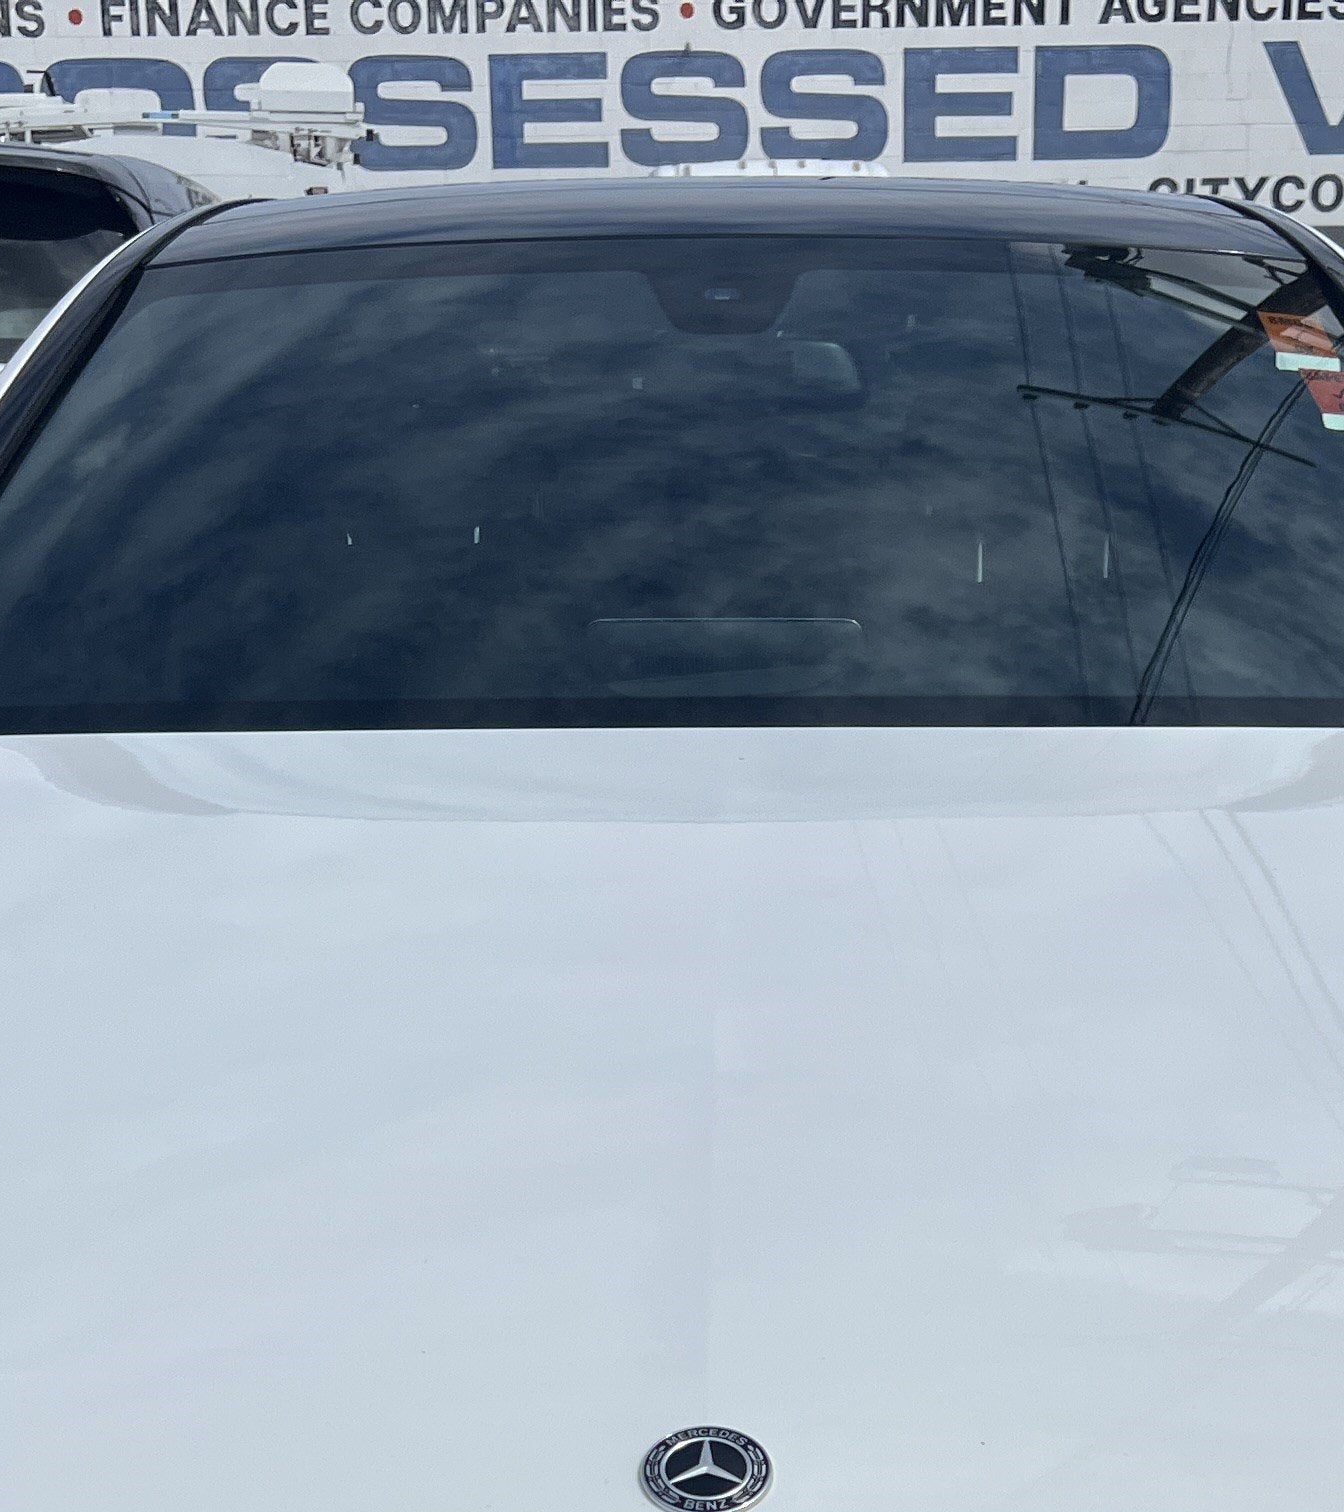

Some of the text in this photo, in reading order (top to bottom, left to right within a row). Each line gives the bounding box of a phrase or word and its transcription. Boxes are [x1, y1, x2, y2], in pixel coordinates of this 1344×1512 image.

[101, 0, 331, 37] FINANCE
[349, 0, 661, 36] COMPANIES
[712, 0, 1071, 30] GOVERNMENT
[665, 1427, 749, 1447] MERCEDES
[683, 1499, 731, 1512] BENZ
